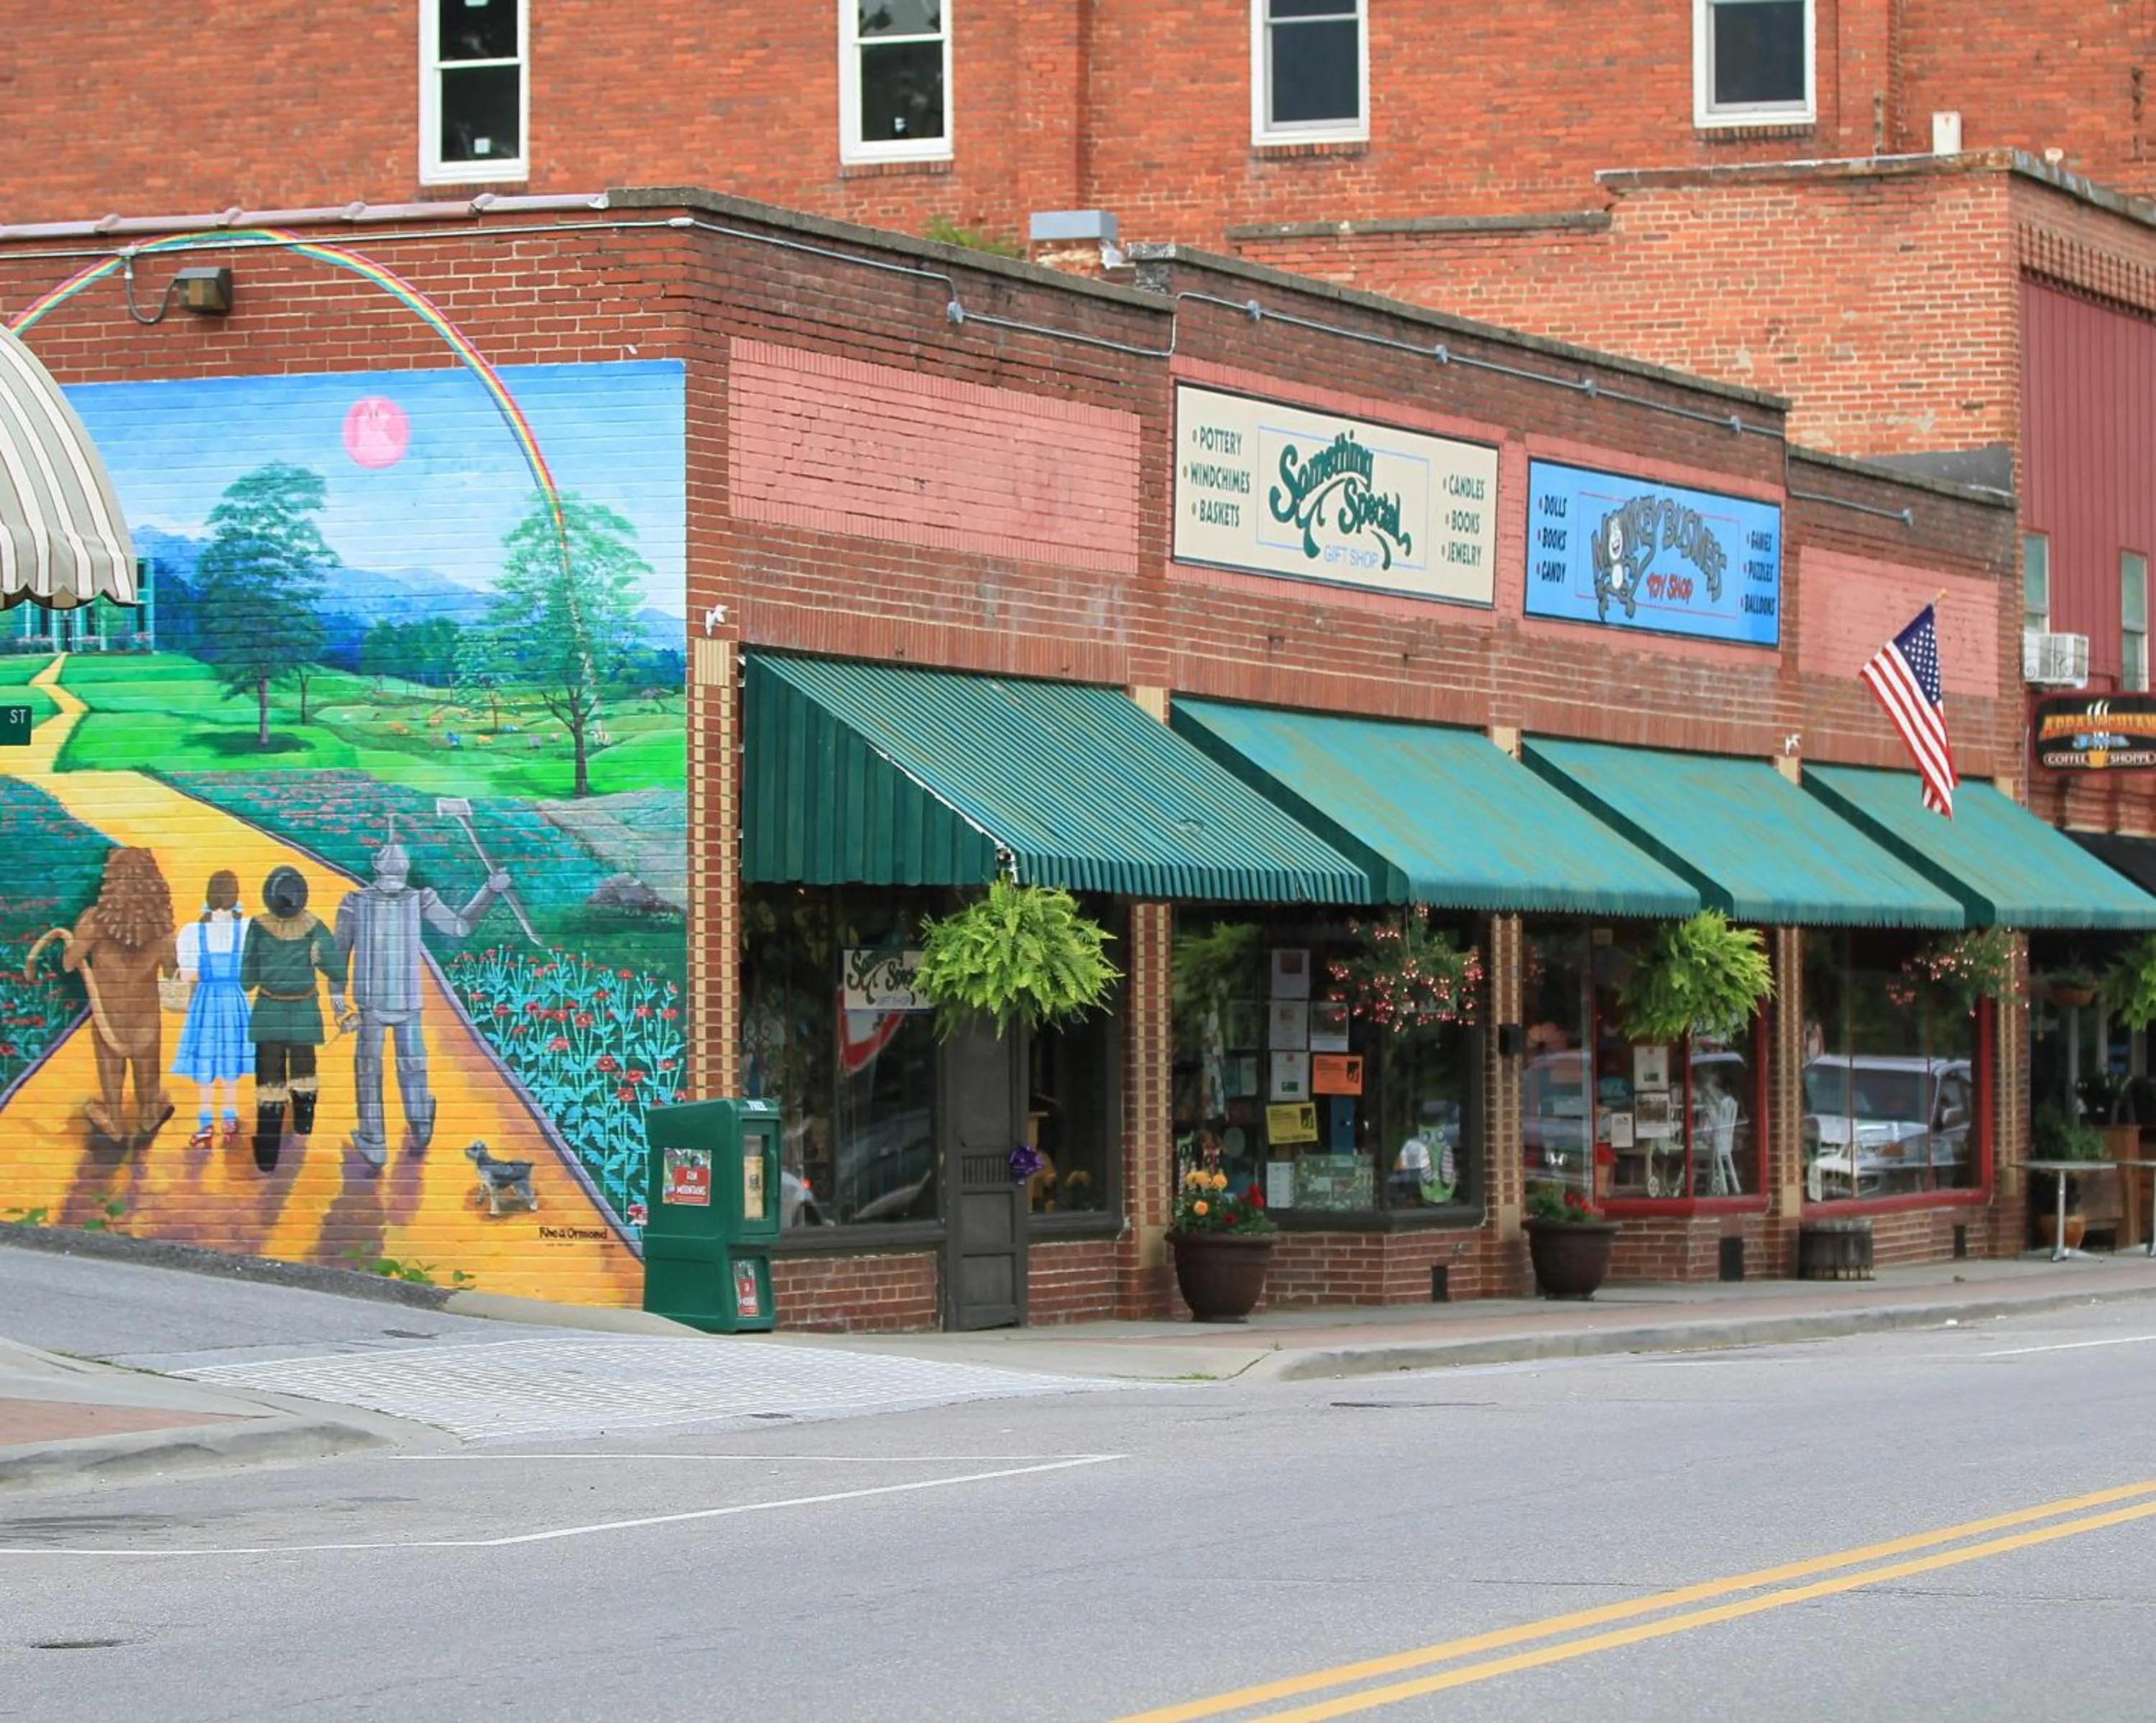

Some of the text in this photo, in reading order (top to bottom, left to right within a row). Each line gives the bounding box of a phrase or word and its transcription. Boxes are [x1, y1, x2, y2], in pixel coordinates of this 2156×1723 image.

[1200, 425, 1243, 456] POTTERY
[1190, 462, 1250, 495] WINDCHIMES
[1269, 430, 1375, 522] Something
[1449, 474, 1484, 501] CANDLES
[1199, 499, 1240, 528] BASKETS
[1337, 476, 1412, 557] Special
[1450, 511, 1480, 535] BOOKS
[1542, 527, 1567, 551] BOOKS
[1324, 544, 1380, 569] GIFT SHOP
[1446, 542, 1483, 568] JEWELRY
[1541, 561, 1567, 584] CANDY
[1646, 572, 1667, 601] TOY
[9, 709, 27, 724] ST
[540, 1227, 608, 1239] Rhea Ormond
